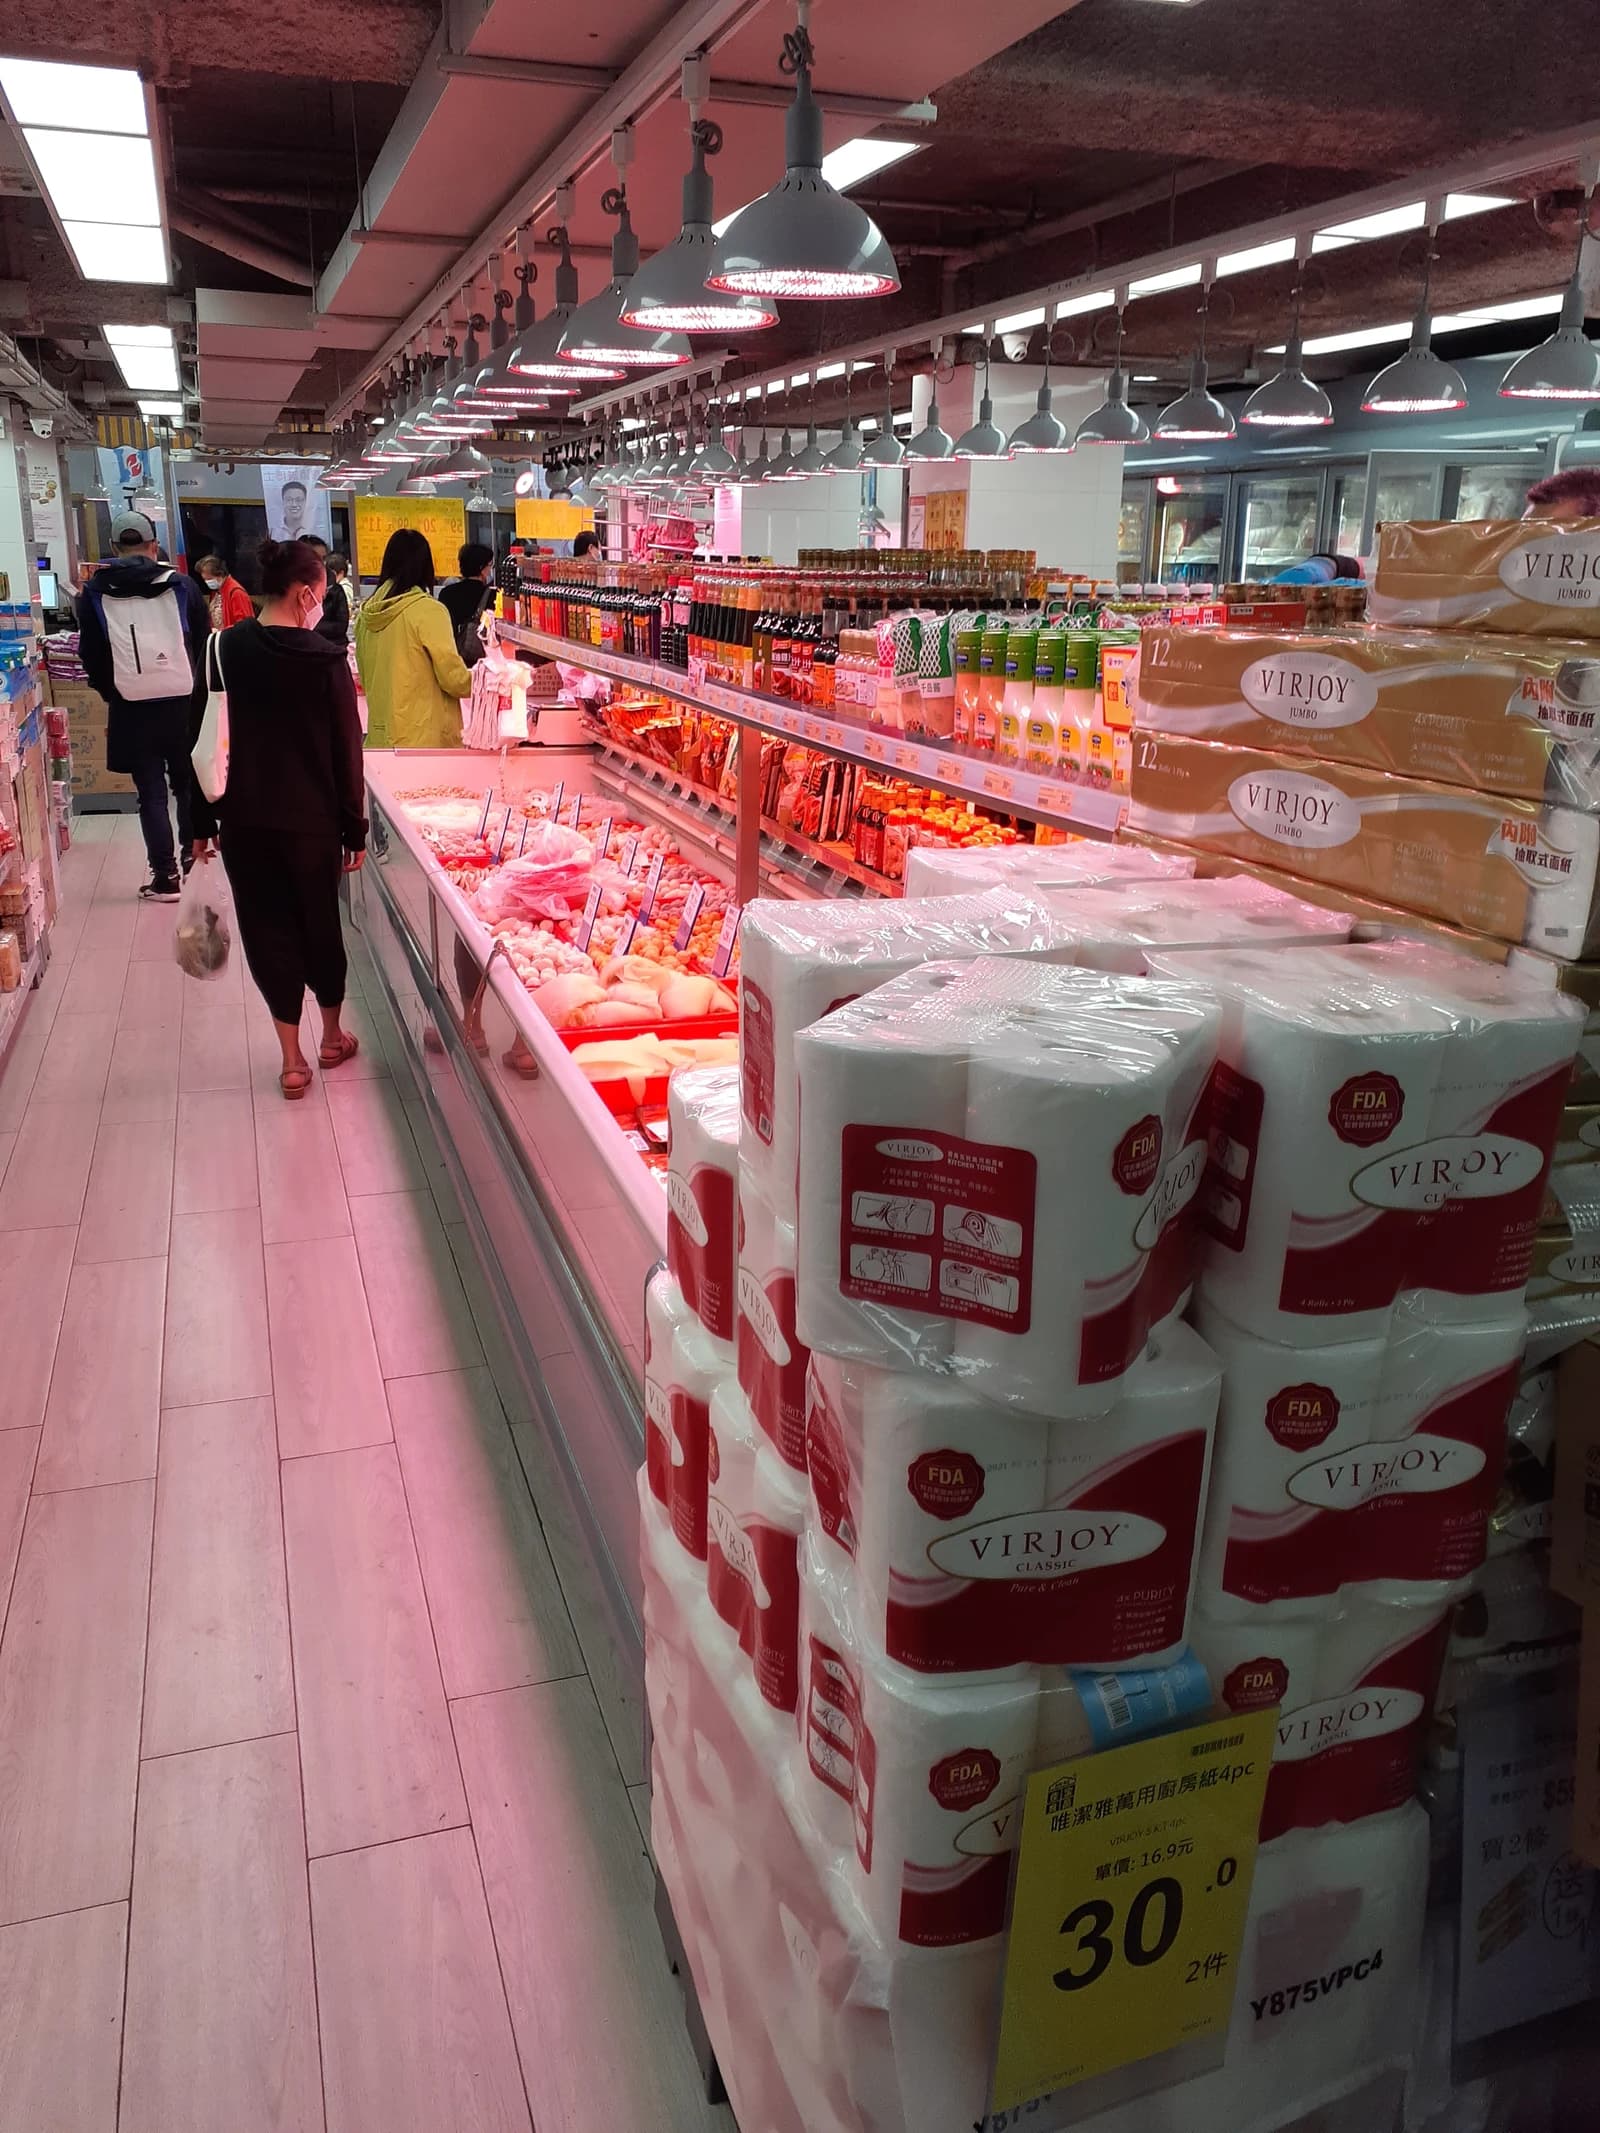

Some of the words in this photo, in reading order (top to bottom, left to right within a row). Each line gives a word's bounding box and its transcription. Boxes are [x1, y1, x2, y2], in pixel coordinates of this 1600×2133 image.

[1557, 588, 1591, 600] JUMBO
[1150, 638, 1168, 667] 12
[1260, 669, 1352, 705] VIRJOY
[1289, 707, 1318, 720] JUMBO
[1138, 740, 1158, 768] 12
[1246, 783, 1335, 826] VIRJOY
[1274, 823, 1302, 840] JUMBO
[1353, 1091, 1387, 1109] FDA
[887, 1143, 934, 1156] VIRJOY
[1132, 1134, 1156, 1158] FDA
[742, 1279, 778, 1344] VIRJOY
[1288, 1400, 1322, 1417] FDA
[928, 1465, 965, 1484] FDA
[970, 1524, 1122, 1561] VIRJOY
[1016, 1560, 1076, 1573] CLASSIC
[1038, 1581, 1046, 1592] &
[1134, 1584, 1175, 1602] PURITY
[1242, 1672, 1274, 1688] FDA
[1278, 1698, 1392, 1746] VIRJOY
[949, 1766, 982, 1783] FDA
[1050, 1761, 1256, 1832] 唯潔雅萬用廚房紙4pc
[1095, 1856, 1136, 1881] 單價:
[1142, 1837, 1194, 1868] 16.9元
[1052, 1877, 1184, 1992] 30
[1184, 1950, 1228, 1984] 2件
[1250, 1948, 1384, 2022] Y875VPC4
